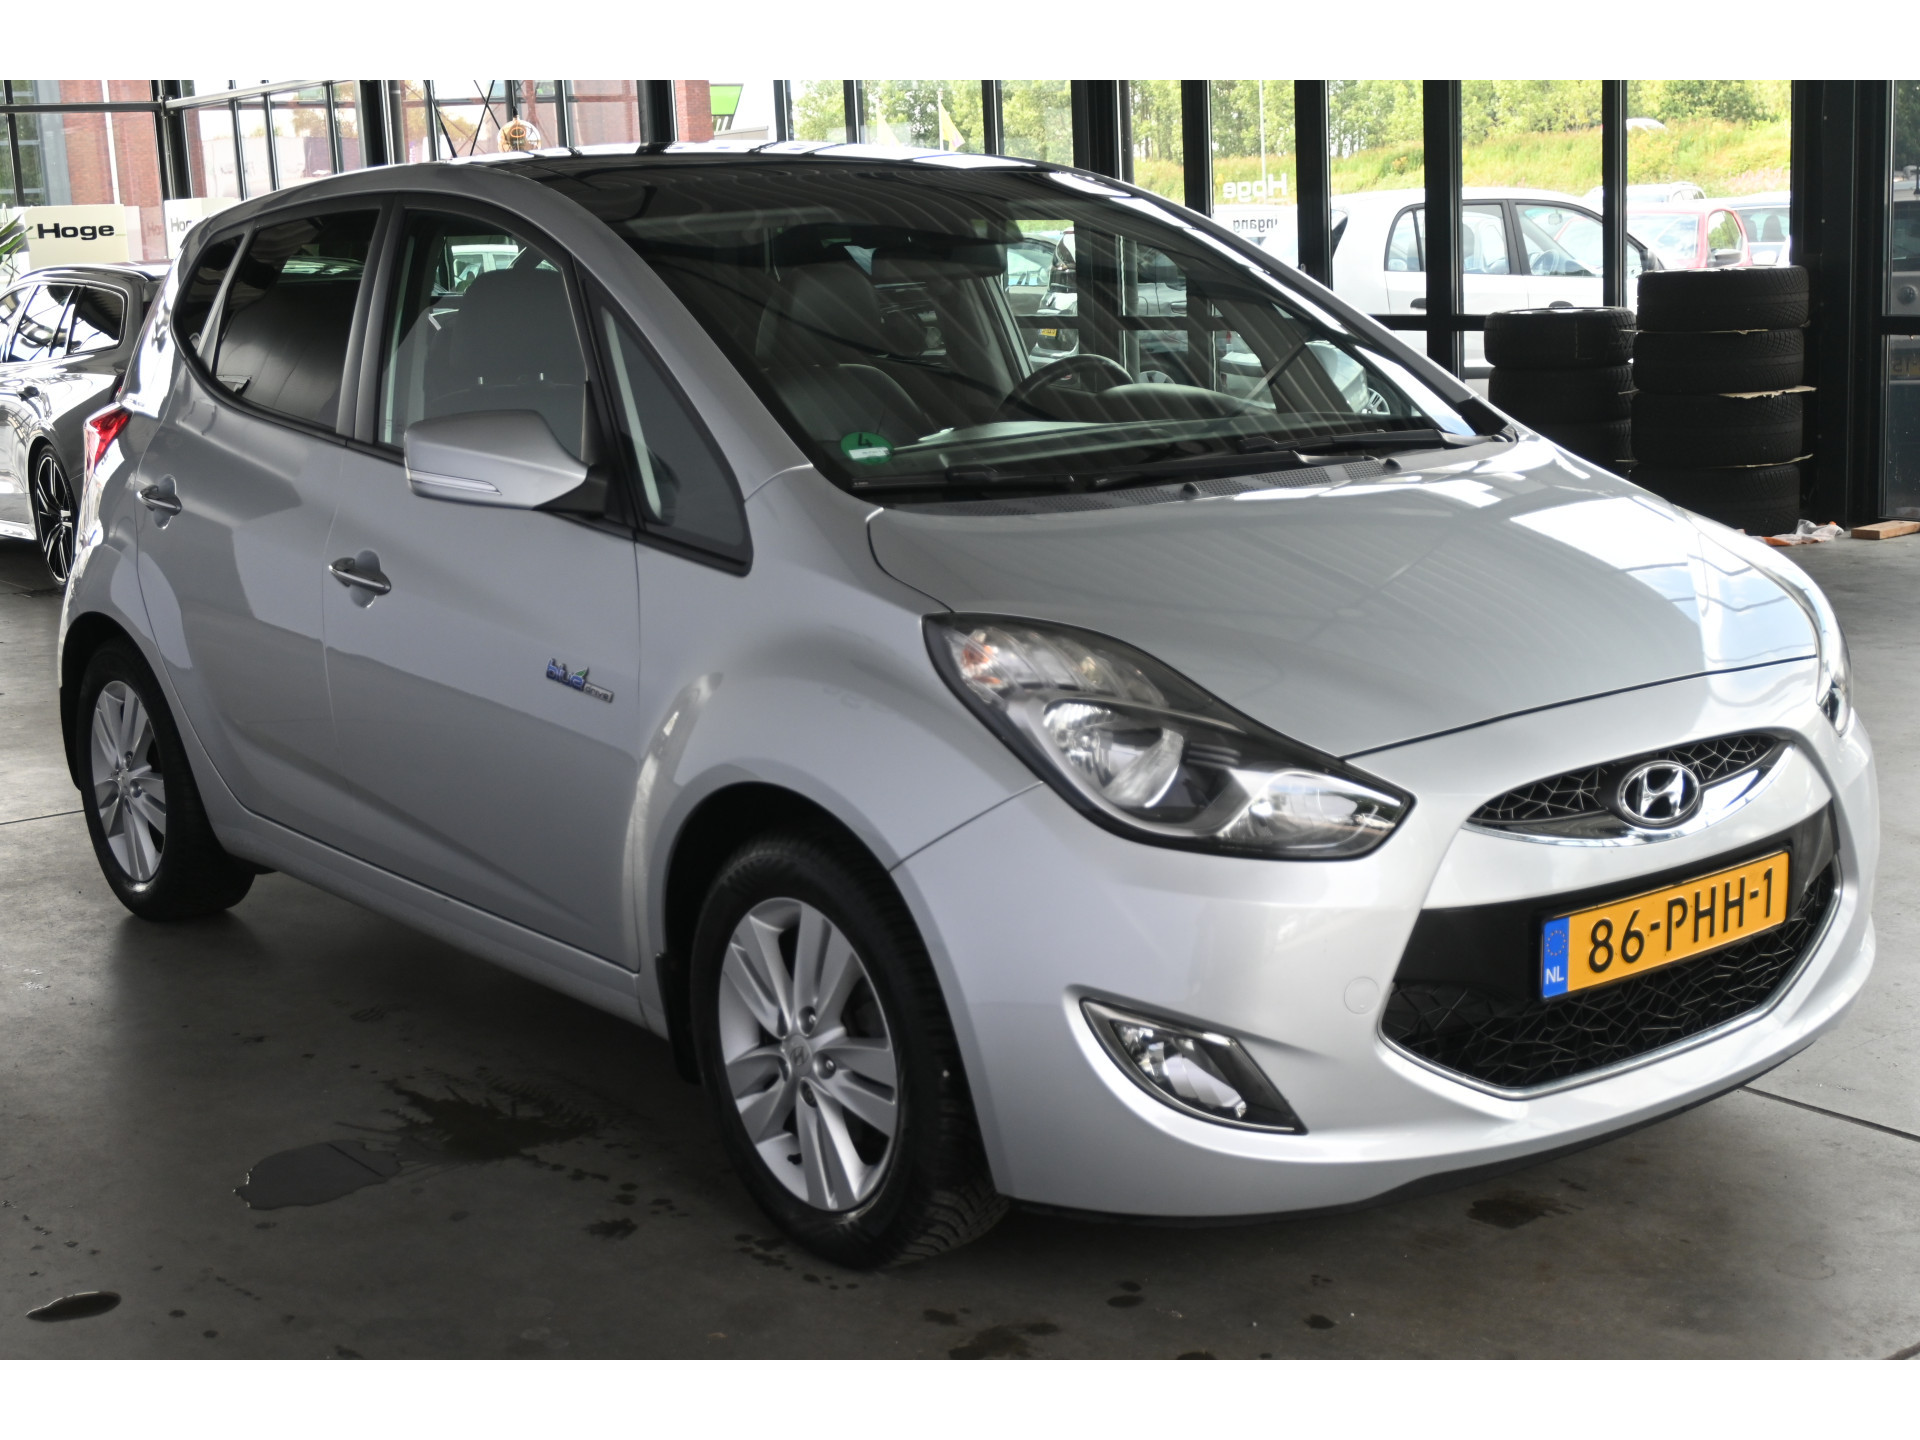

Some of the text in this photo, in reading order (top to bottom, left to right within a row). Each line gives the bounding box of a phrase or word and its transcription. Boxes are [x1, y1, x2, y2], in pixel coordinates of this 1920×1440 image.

[37, 222, 115, 241] Hoge
[1545, 866, 1773, 985] NL 86-PHH-1
